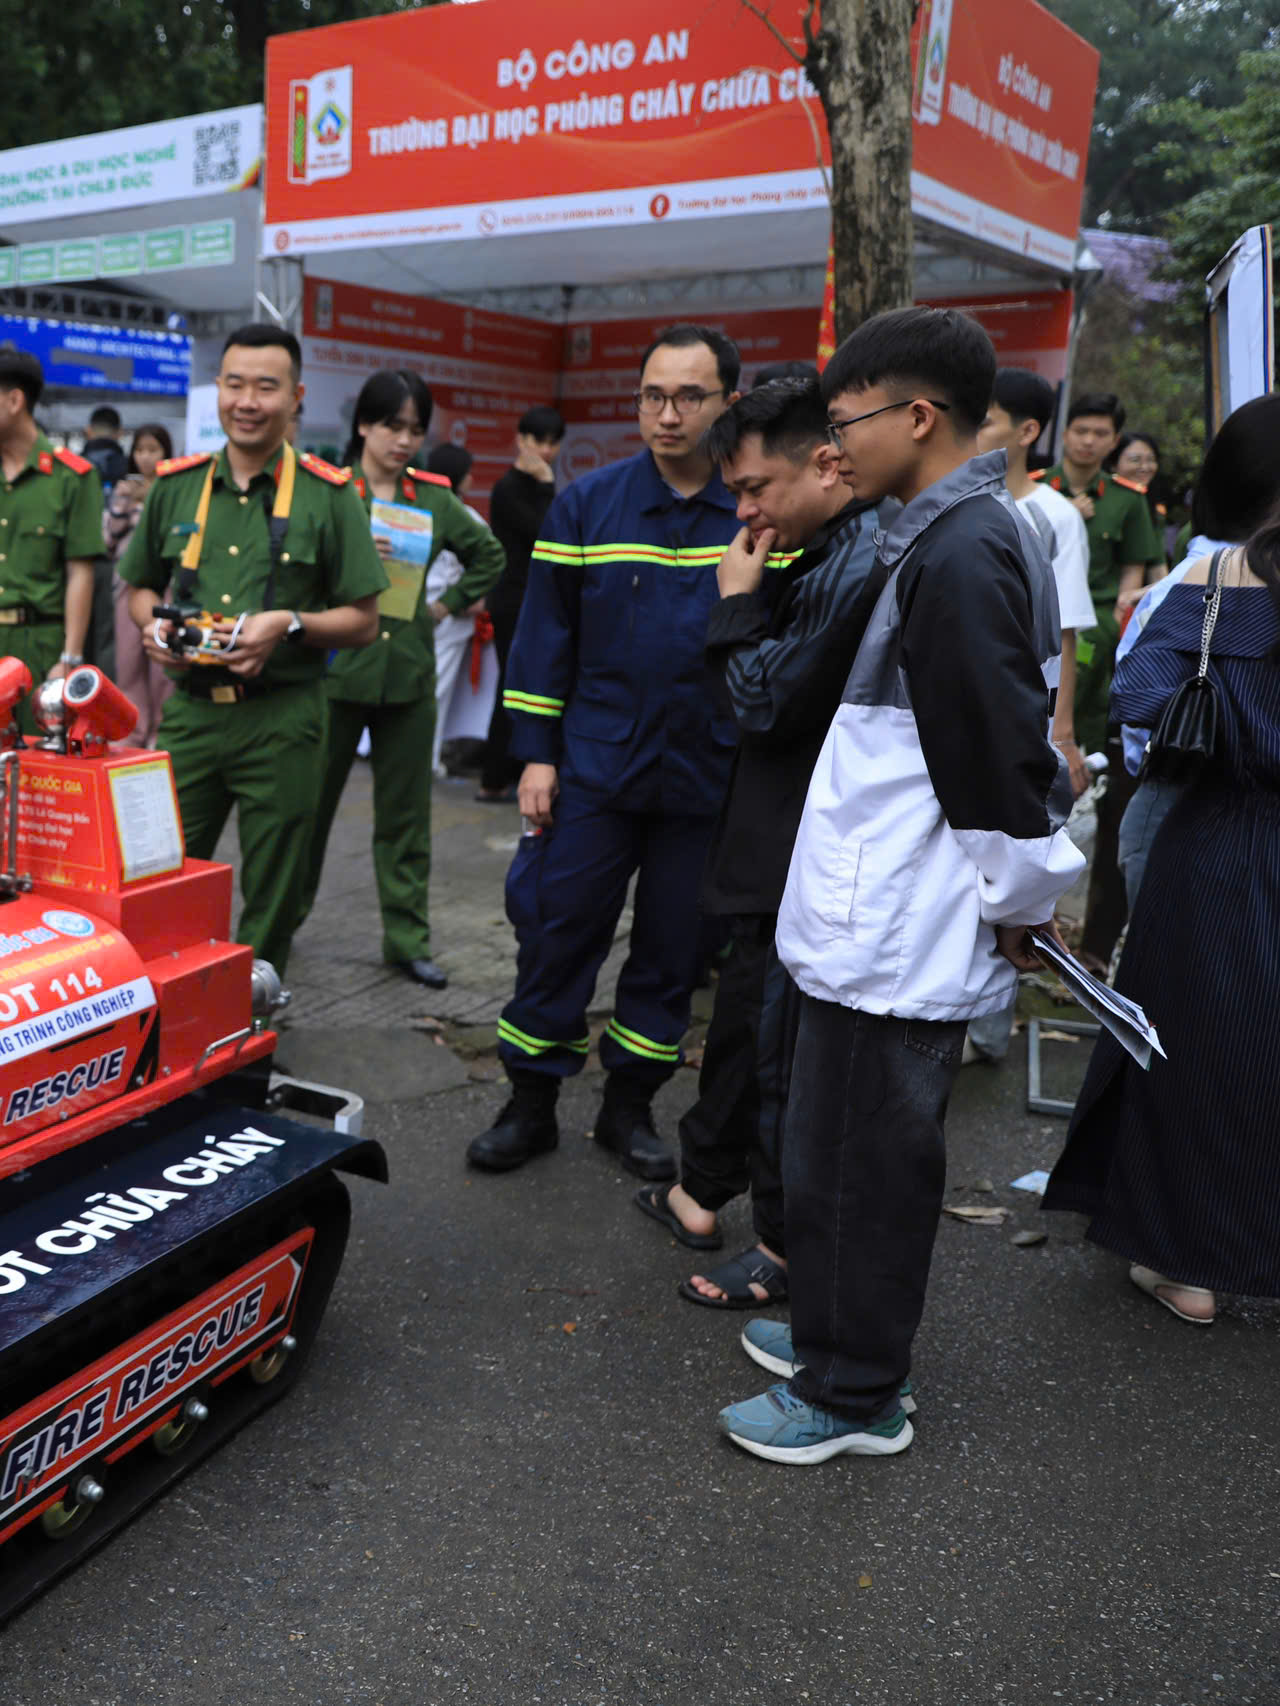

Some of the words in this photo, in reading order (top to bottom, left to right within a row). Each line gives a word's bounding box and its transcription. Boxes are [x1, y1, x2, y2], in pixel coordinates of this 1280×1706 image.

[497, 48, 537, 91] BỘ
[544, 38, 635, 80] CÔNG
[642, 28, 689, 65] AN
[368, 115, 448, 156] TRƯỜNG
[452, 111, 489, 149] ĐẠI
[494, 105, 539, 144] HỌC
[544, 91, 624, 134] PHÒNG
[629, 79, 696, 122] CHÁY
[701, 66, 771, 112] CHỮA
[31, 774, 62, 791] QUỐC
[64, 779, 83, 792] GIA
[21, 925, 60, 945] GIA
[48, 966, 103, 1002] 114
[13, 1020, 57, 1049] TRÌNH
[55, 1006, 93, 1033] CÔNG
[91, 988, 136, 1018] NGHIỆP
[3, 1046, 128, 1127] RESCUE
[35, 1186, 189, 1256] CHỮA
[162, 1126, 287, 1187] CHÁY
[112, 1281, 267, 1424] RESCUE
